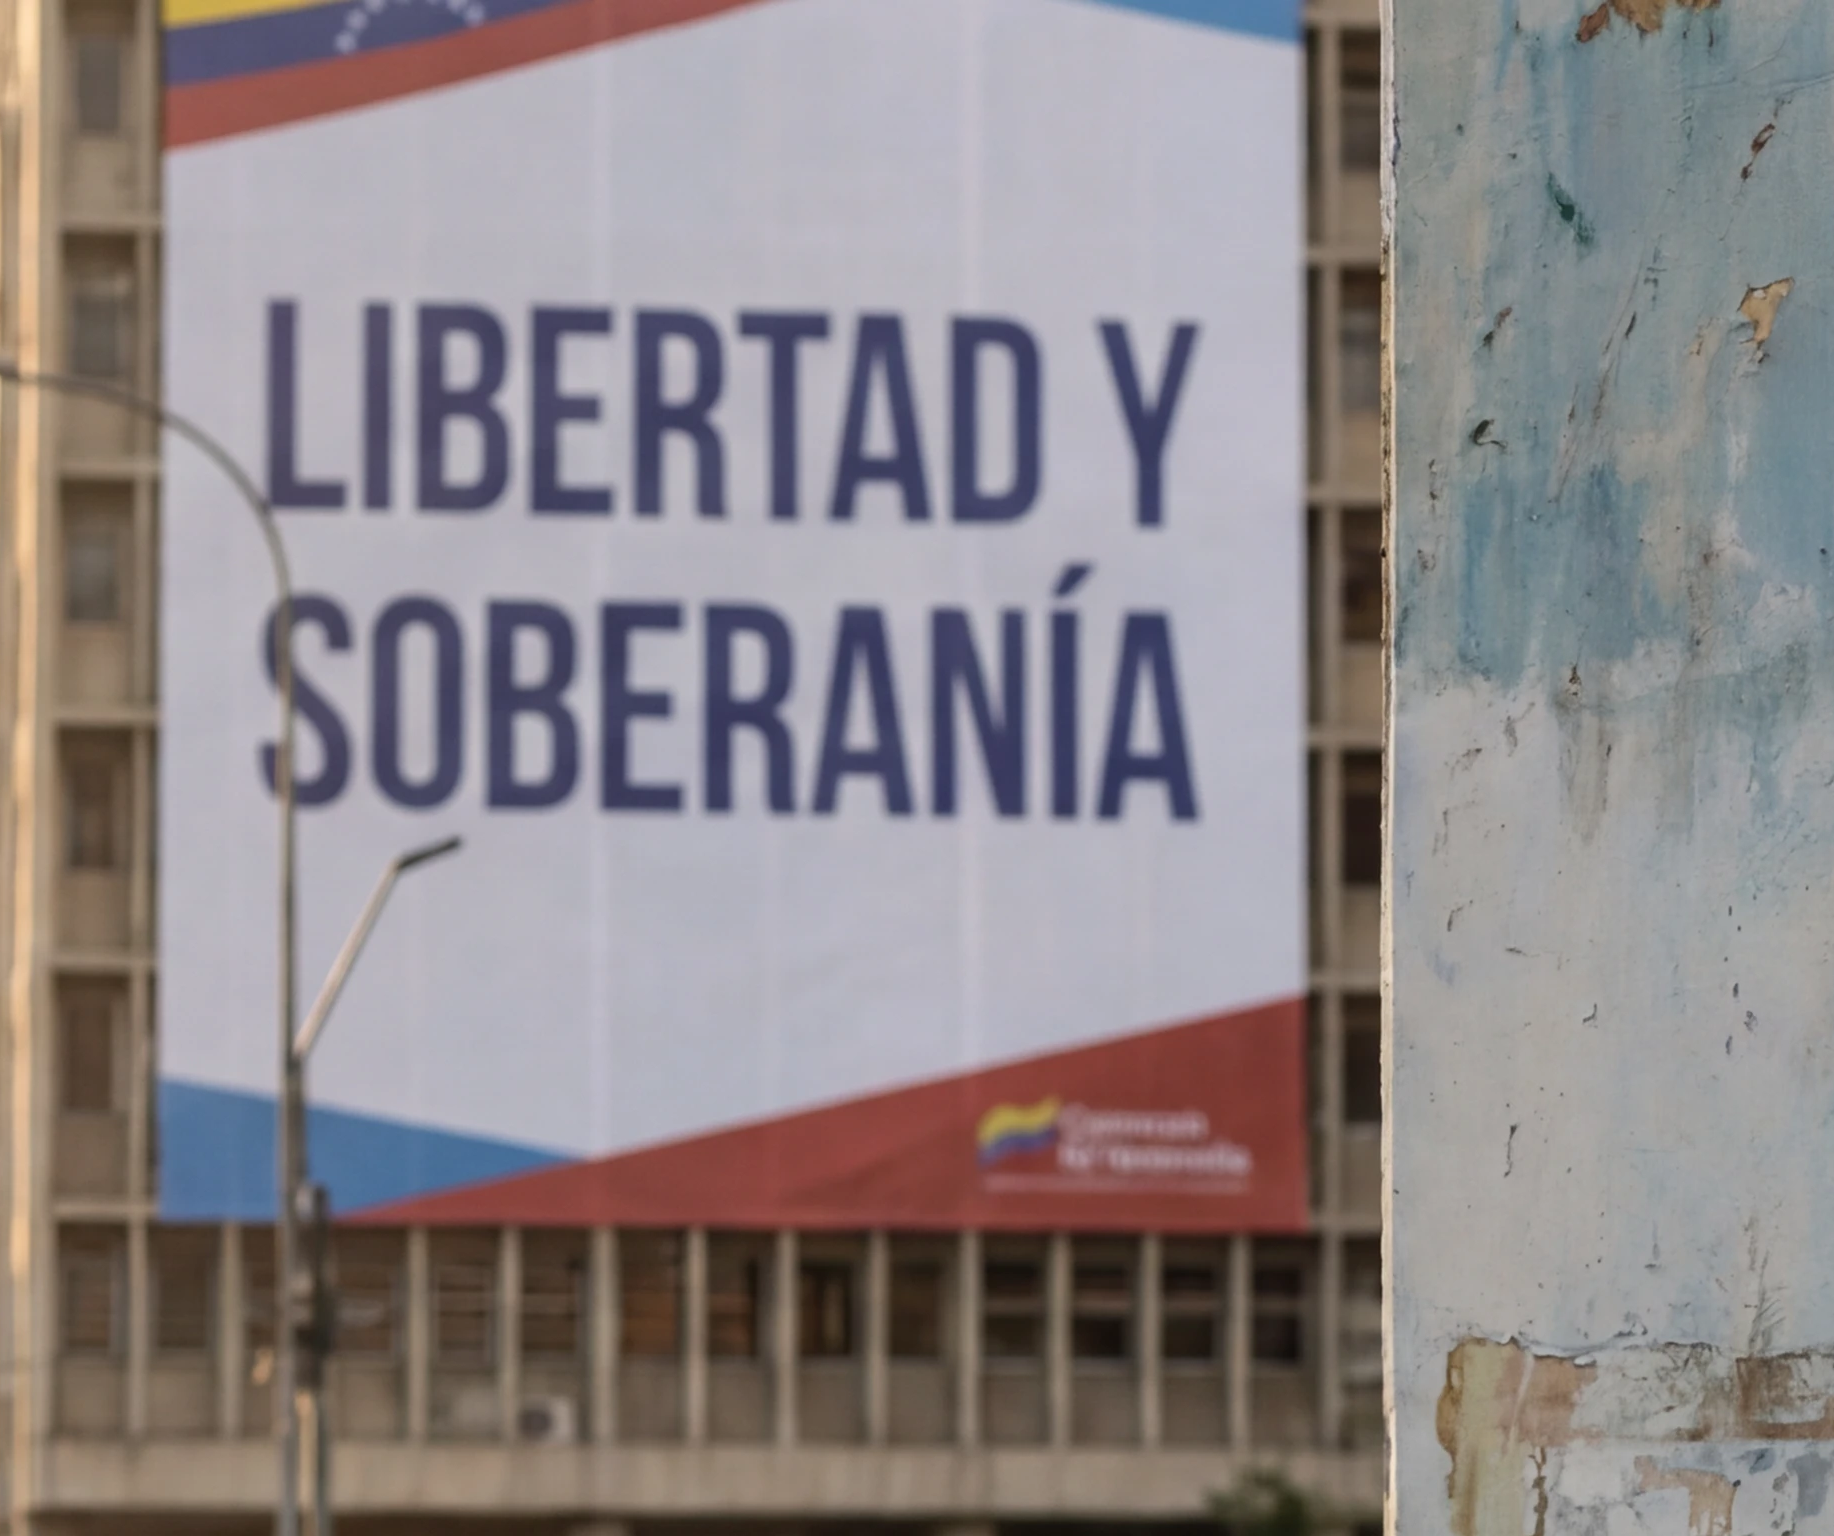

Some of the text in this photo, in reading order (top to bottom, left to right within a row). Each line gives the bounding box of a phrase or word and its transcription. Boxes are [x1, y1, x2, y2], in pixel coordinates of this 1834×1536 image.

[264, 300, 1201, 530] LIBERTAD Y
[259, 563, 1201, 822] SOBERANÍA
